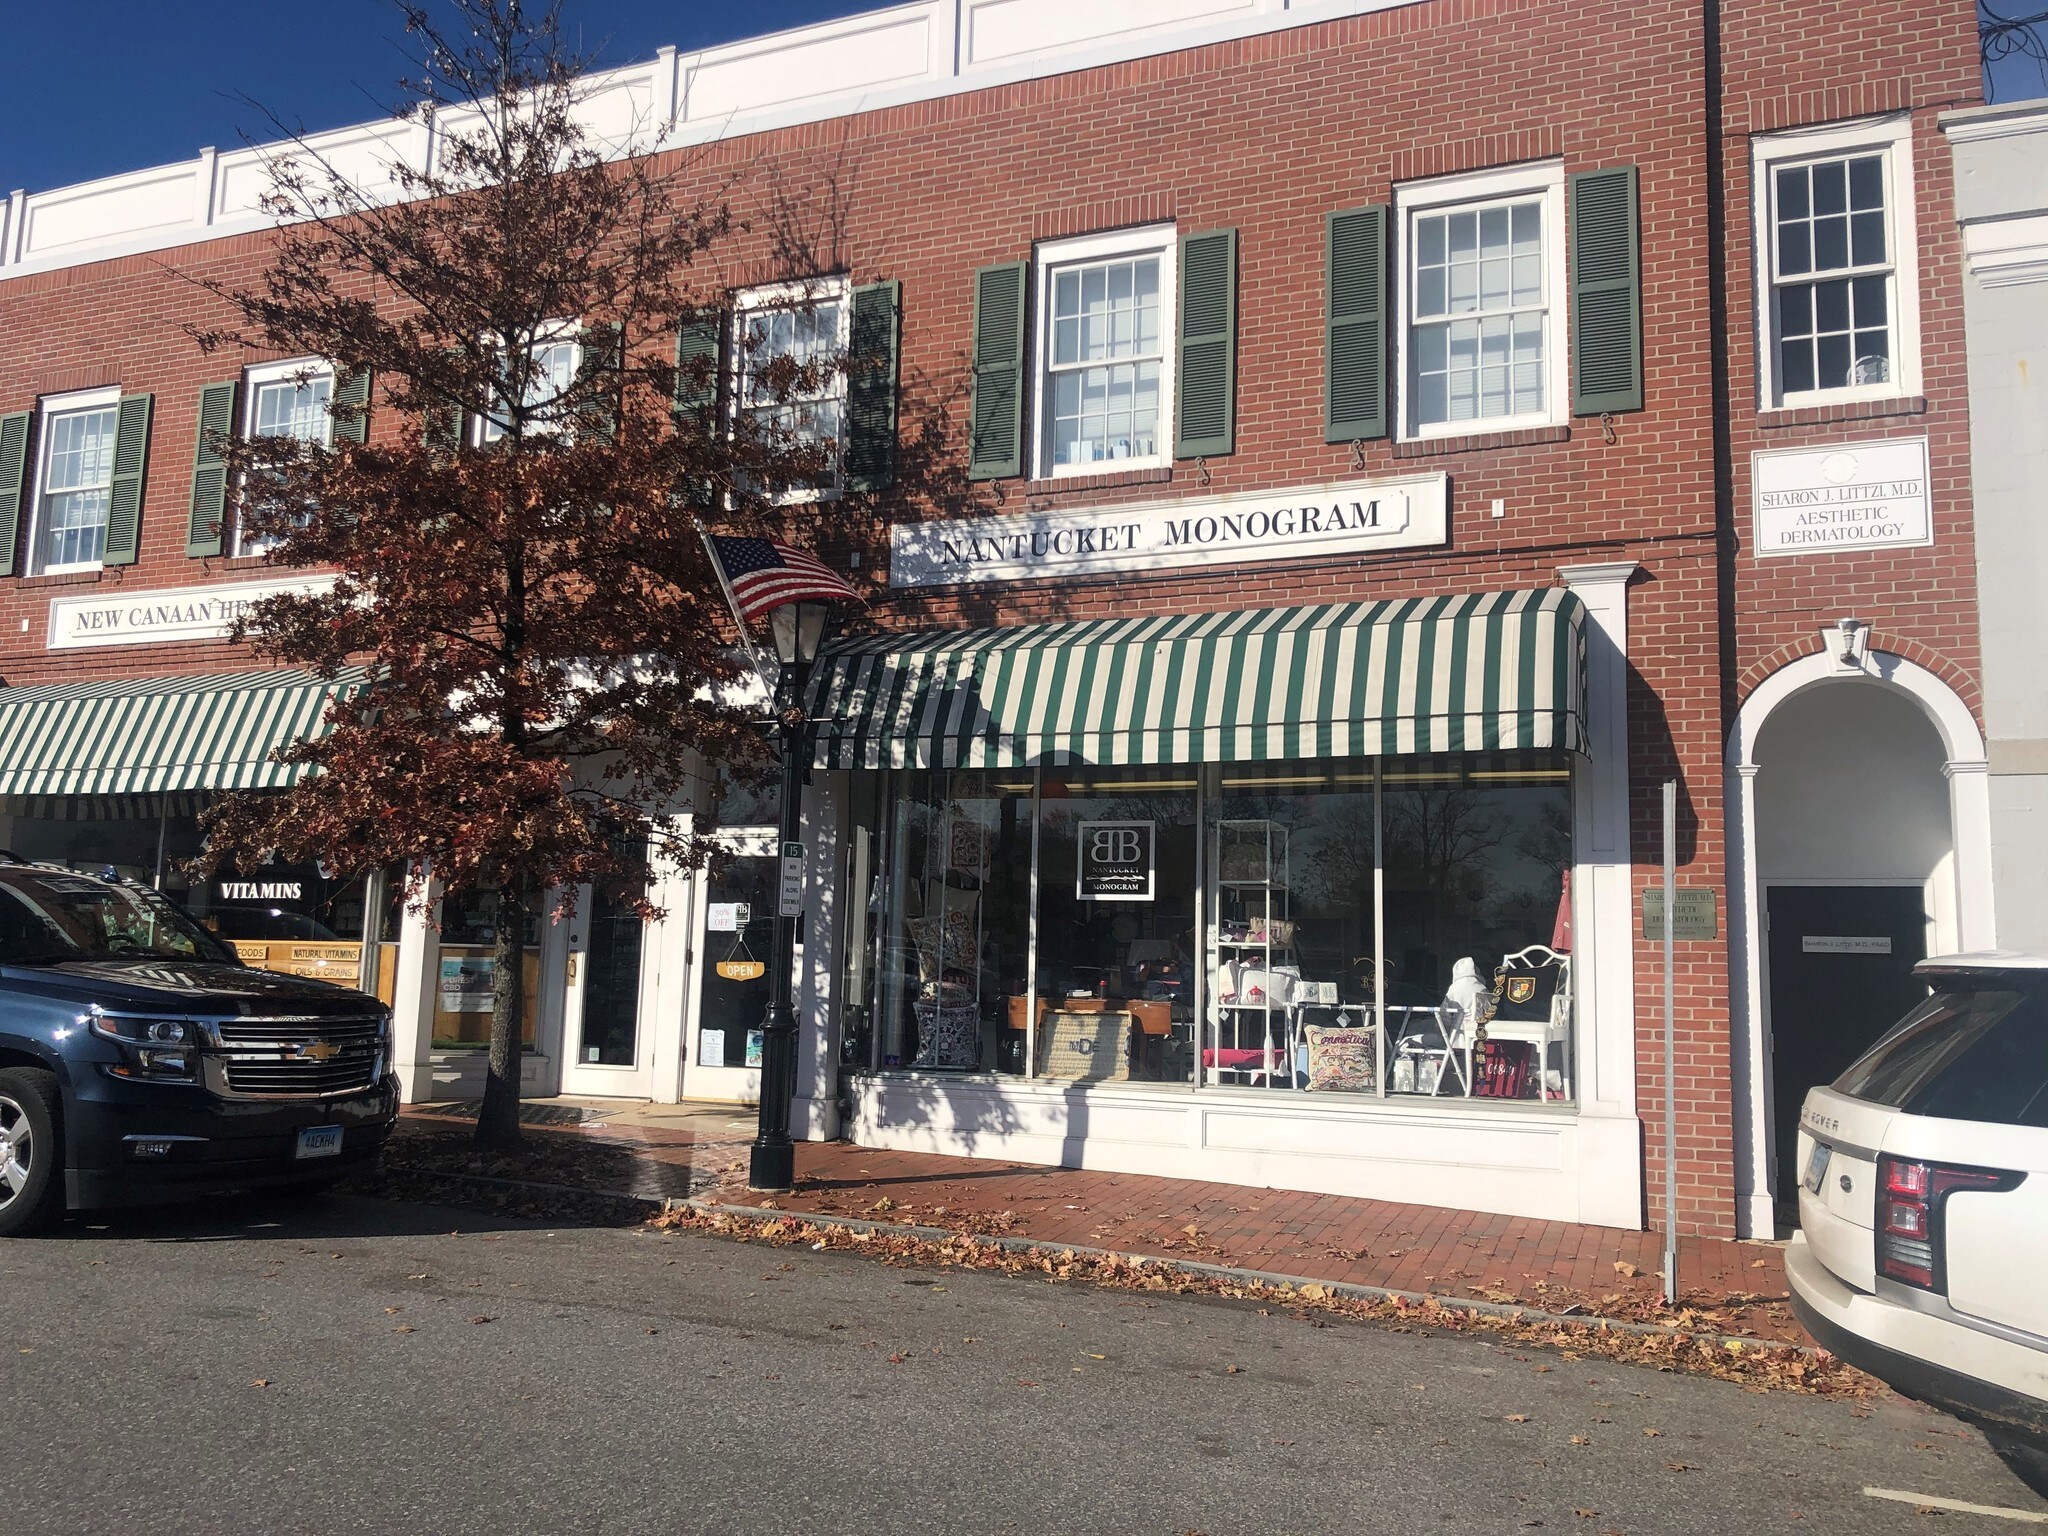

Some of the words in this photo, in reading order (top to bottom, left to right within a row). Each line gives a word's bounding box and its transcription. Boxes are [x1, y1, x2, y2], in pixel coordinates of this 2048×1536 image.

[1762, 490, 1819, 507] SHARON
[1824, 490, 1834, 502] J.
[1892, 482, 1922, 496] M.D.
[1796, 506, 1889, 526] AESTHETIC
[942, 523, 1142, 565] NANTUCKET
[1163, 500, 1382, 547] MONOGRAM
[1781, 523, 1905, 545] DERMATOLOGY
[76, 609, 125, 631] NEW
[128, 602, 213, 627] CANAAN
[790, 846, 798, 857] 15
[221, 883, 302, 900] VITAMINS
[714, 918, 730, 927] OFF
[237, 948, 264, 958] FOODS
[293, 949, 322, 959] NATURAL
[325, 949, 358, 960] VITAMINS
[295, 967, 313, 977] OILS
[315, 969, 321, 977] &
[323, 968, 353, 978] GRAINS
[727, 965, 754, 977] OPEN
[1811, 1111, 1839, 1131] ROVER
